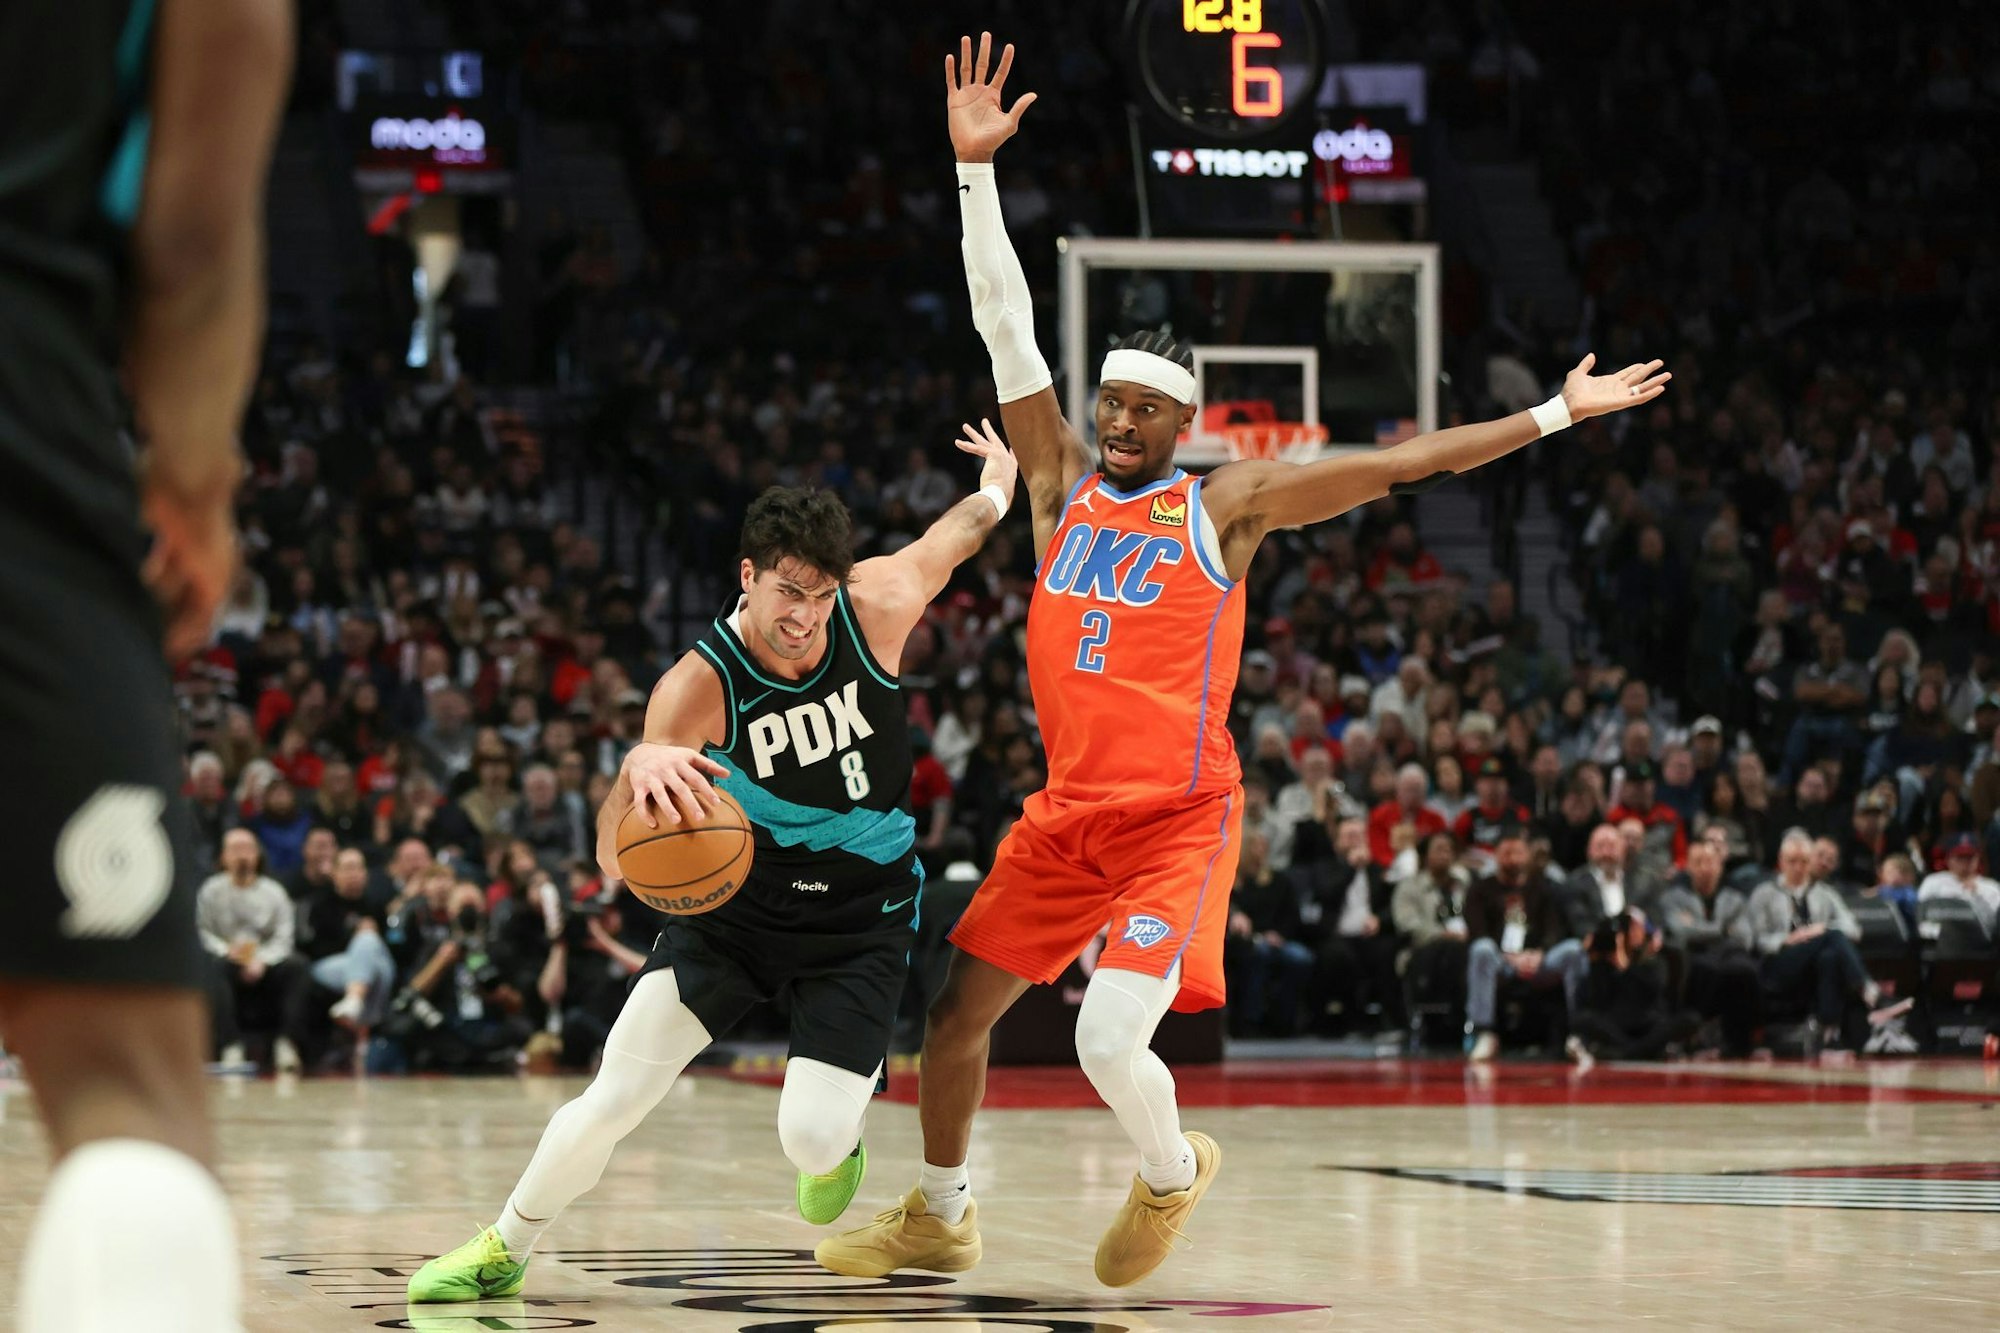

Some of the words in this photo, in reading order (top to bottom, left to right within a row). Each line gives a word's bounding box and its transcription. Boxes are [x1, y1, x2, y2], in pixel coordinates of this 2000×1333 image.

[1232, 32, 1283, 117] 6
[1194, 149, 1309, 178] TISSOT
[1312, 122, 1393, 161] oda
[1044, 523, 1185, 607] OKC
[1074, 609, 1112, 674] 2
[747, 679, 875, 779] PDX
[839, 750, 871, 801] 8
[643, 880, 735, 911] Wilson
[792, 880, 829, 893] ripcity
